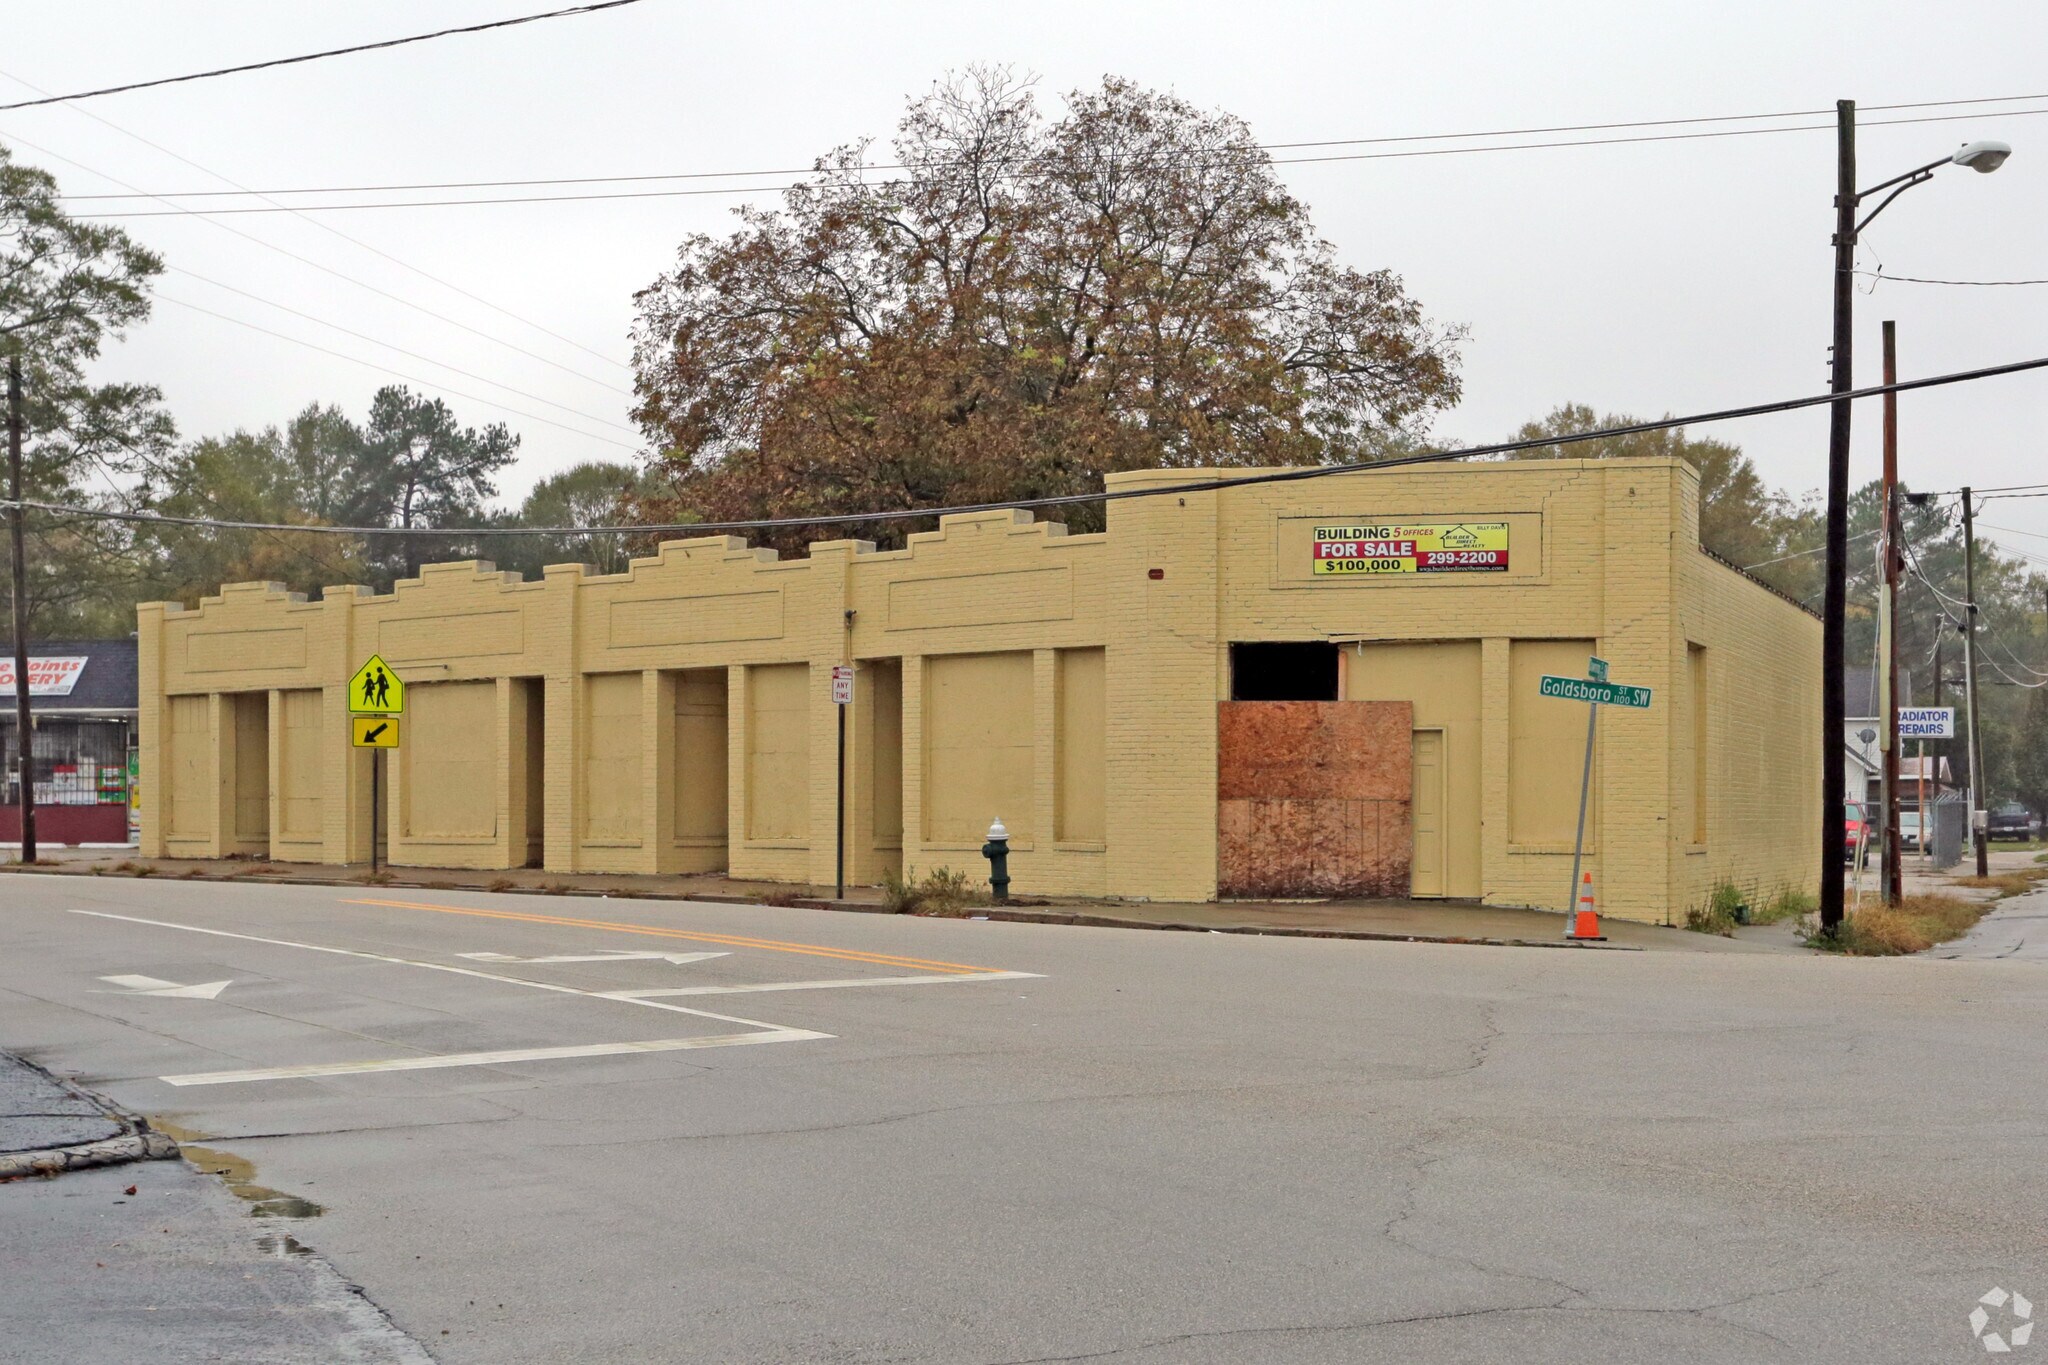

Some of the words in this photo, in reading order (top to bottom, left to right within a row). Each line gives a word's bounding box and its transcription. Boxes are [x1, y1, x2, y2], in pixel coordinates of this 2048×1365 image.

[1317, 528, 1390, 540] BUILDING
[1393, 527, 1401, 538] 5
[1321, 543, 1358, 557] FOR
[1364, 542, 1412, 557] SALE
[1427, 551, 1497, 564] 299-2200
[1326, 559, 1401, 573] $100,000
[28, 660, 80, 671] oints
[836, 691, 849, 700] TIME
[1542, 678, 1611, 701] Goldsboro
[1618, 686, 1628, 695] ST
[1633, 689, 1649, 706] SW
[1613, 695, 1631, 705] 1100
[1898, 723, 1944, 734] REPAIRS
